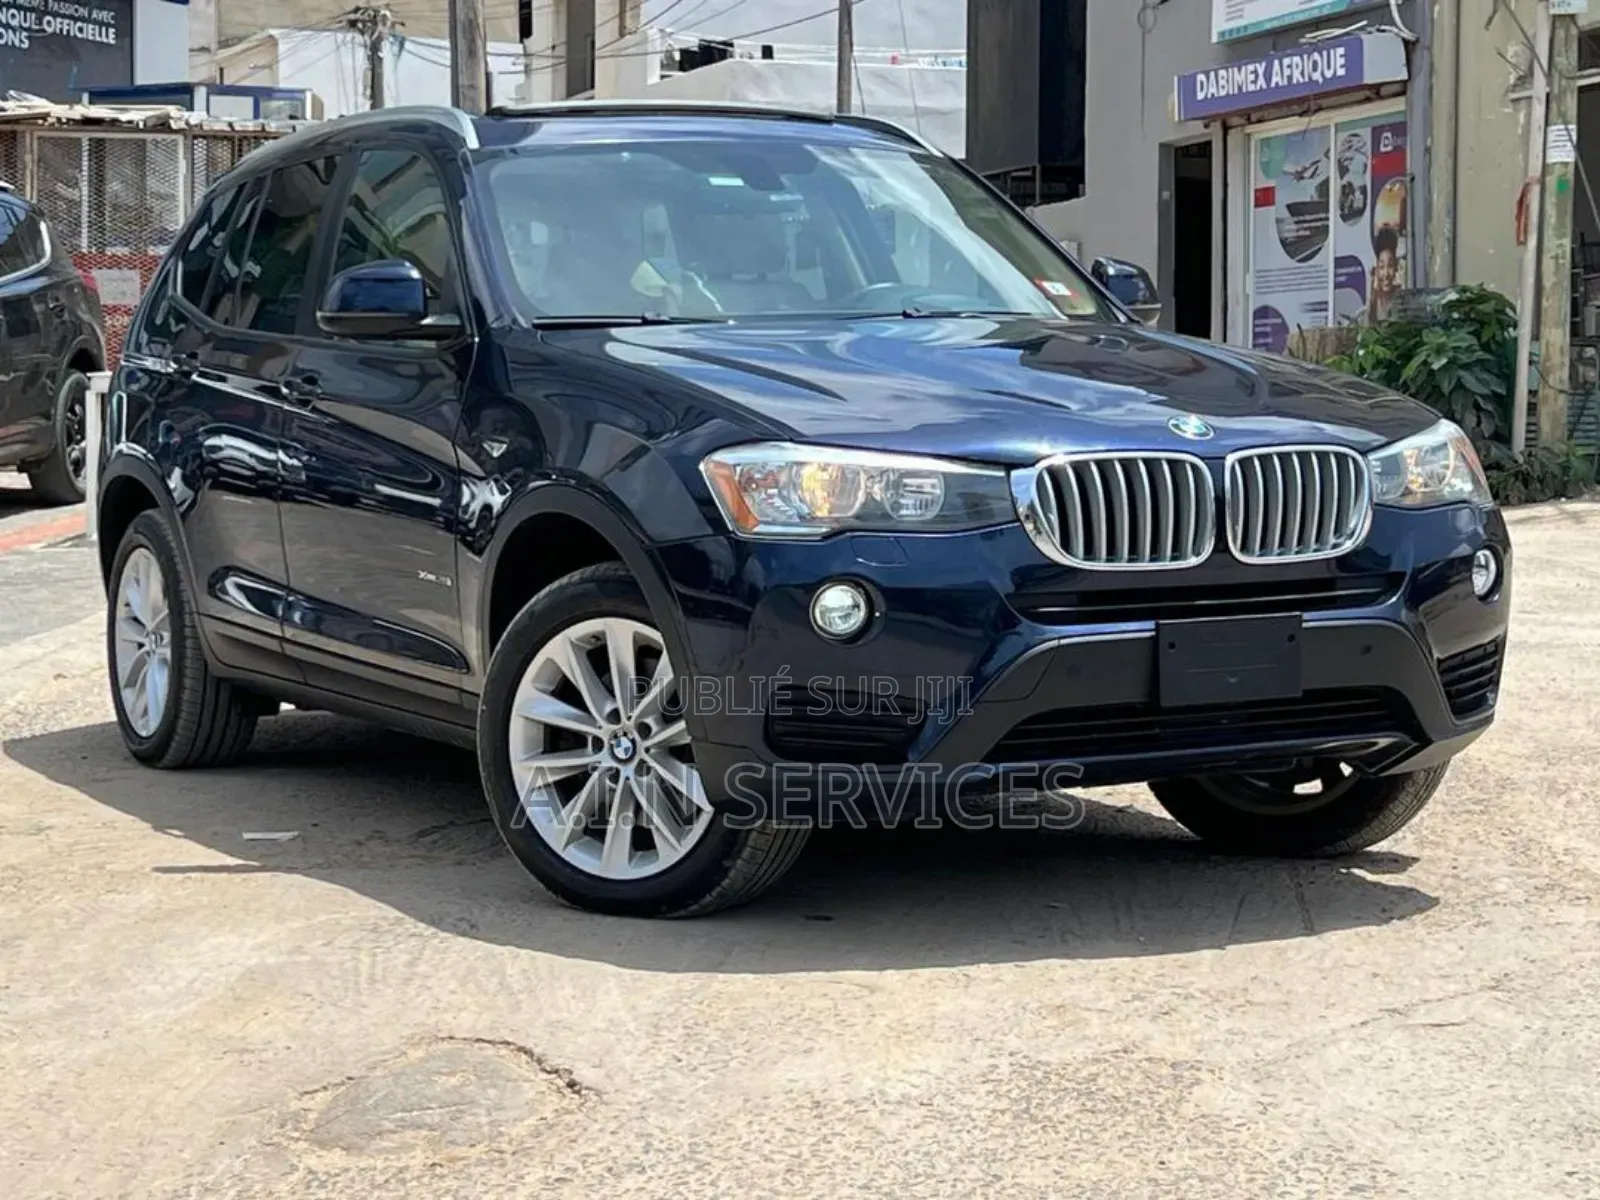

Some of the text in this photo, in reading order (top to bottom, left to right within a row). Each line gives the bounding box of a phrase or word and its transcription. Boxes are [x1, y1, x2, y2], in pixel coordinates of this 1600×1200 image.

[47, 0, 88, 18] PASSION
[91, 8, 116, 24] AVEC
[43, 15, 116, 45] OFFICIELLE
[1196, 47, 1346, 100] DABIMEX AFRIQUE
